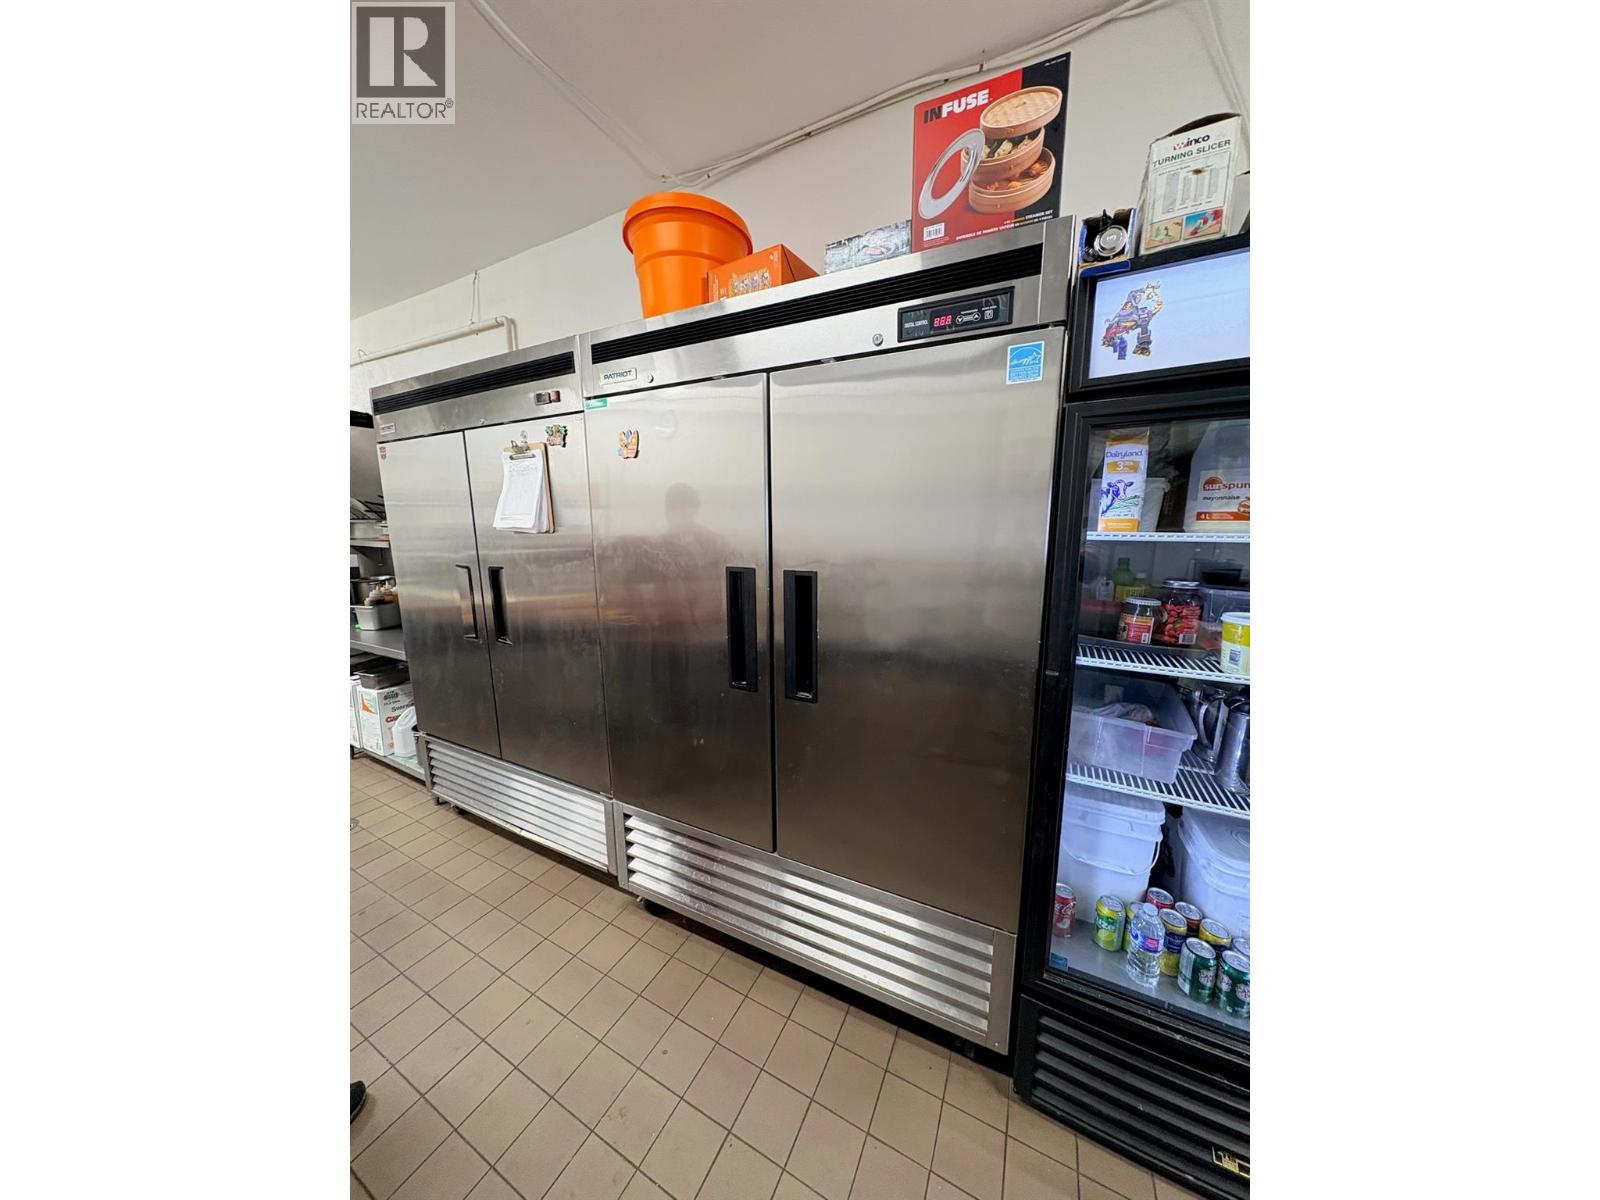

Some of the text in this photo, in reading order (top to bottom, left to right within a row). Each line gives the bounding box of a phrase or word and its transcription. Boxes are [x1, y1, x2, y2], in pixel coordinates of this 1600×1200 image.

[924, 88, 990, 124] INFUSE
[1152, 139, 1231, 168] TURNING SLICER
[603, 370, 632, 380] PATRIOT
[1105, 448, 1143, 460] Dairyland
